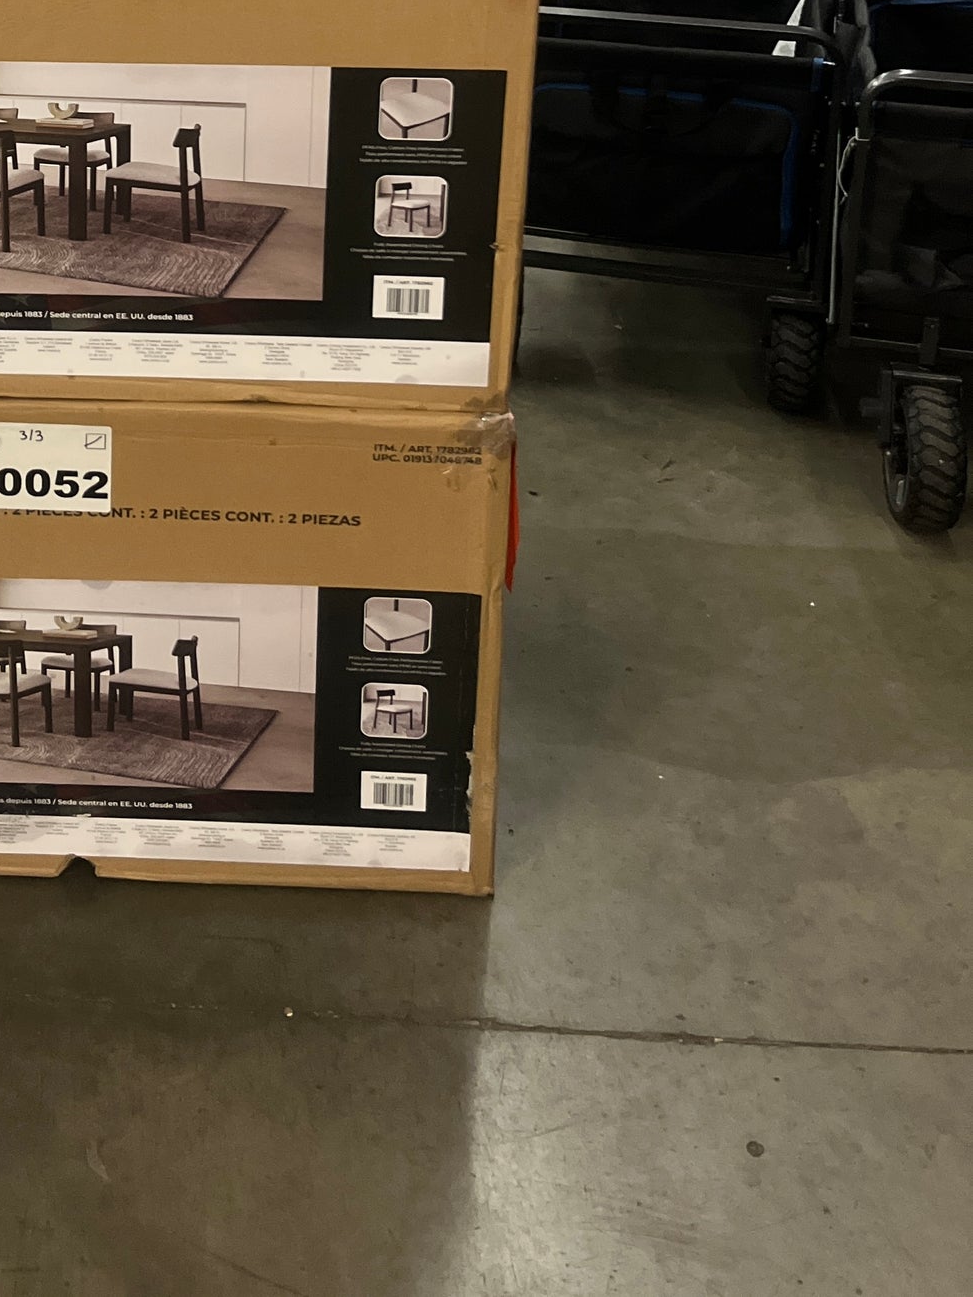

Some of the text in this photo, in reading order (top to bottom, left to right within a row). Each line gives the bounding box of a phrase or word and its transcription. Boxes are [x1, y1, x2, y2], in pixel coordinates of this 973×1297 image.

[72, 311, 101, 319] central
[131, 312, 145, 320] UU.
[147, 312, 172, 320] desde
[175, 313, 194, 321] 1883
[19, 429, 44, 442] 3/3
[373, 444, 397, 452] ITM.
[408, 445, 432, 453] ART.
[372, 454, 400, 462] UPC.
[149, 509, 159, 520] 2
[163, 507, 221, 522] PIÈCES
[225, 510, 275, 524] CONT.
[288, 512, 298, 525] 2
[303, 513, 362, 527] PIEZAS
